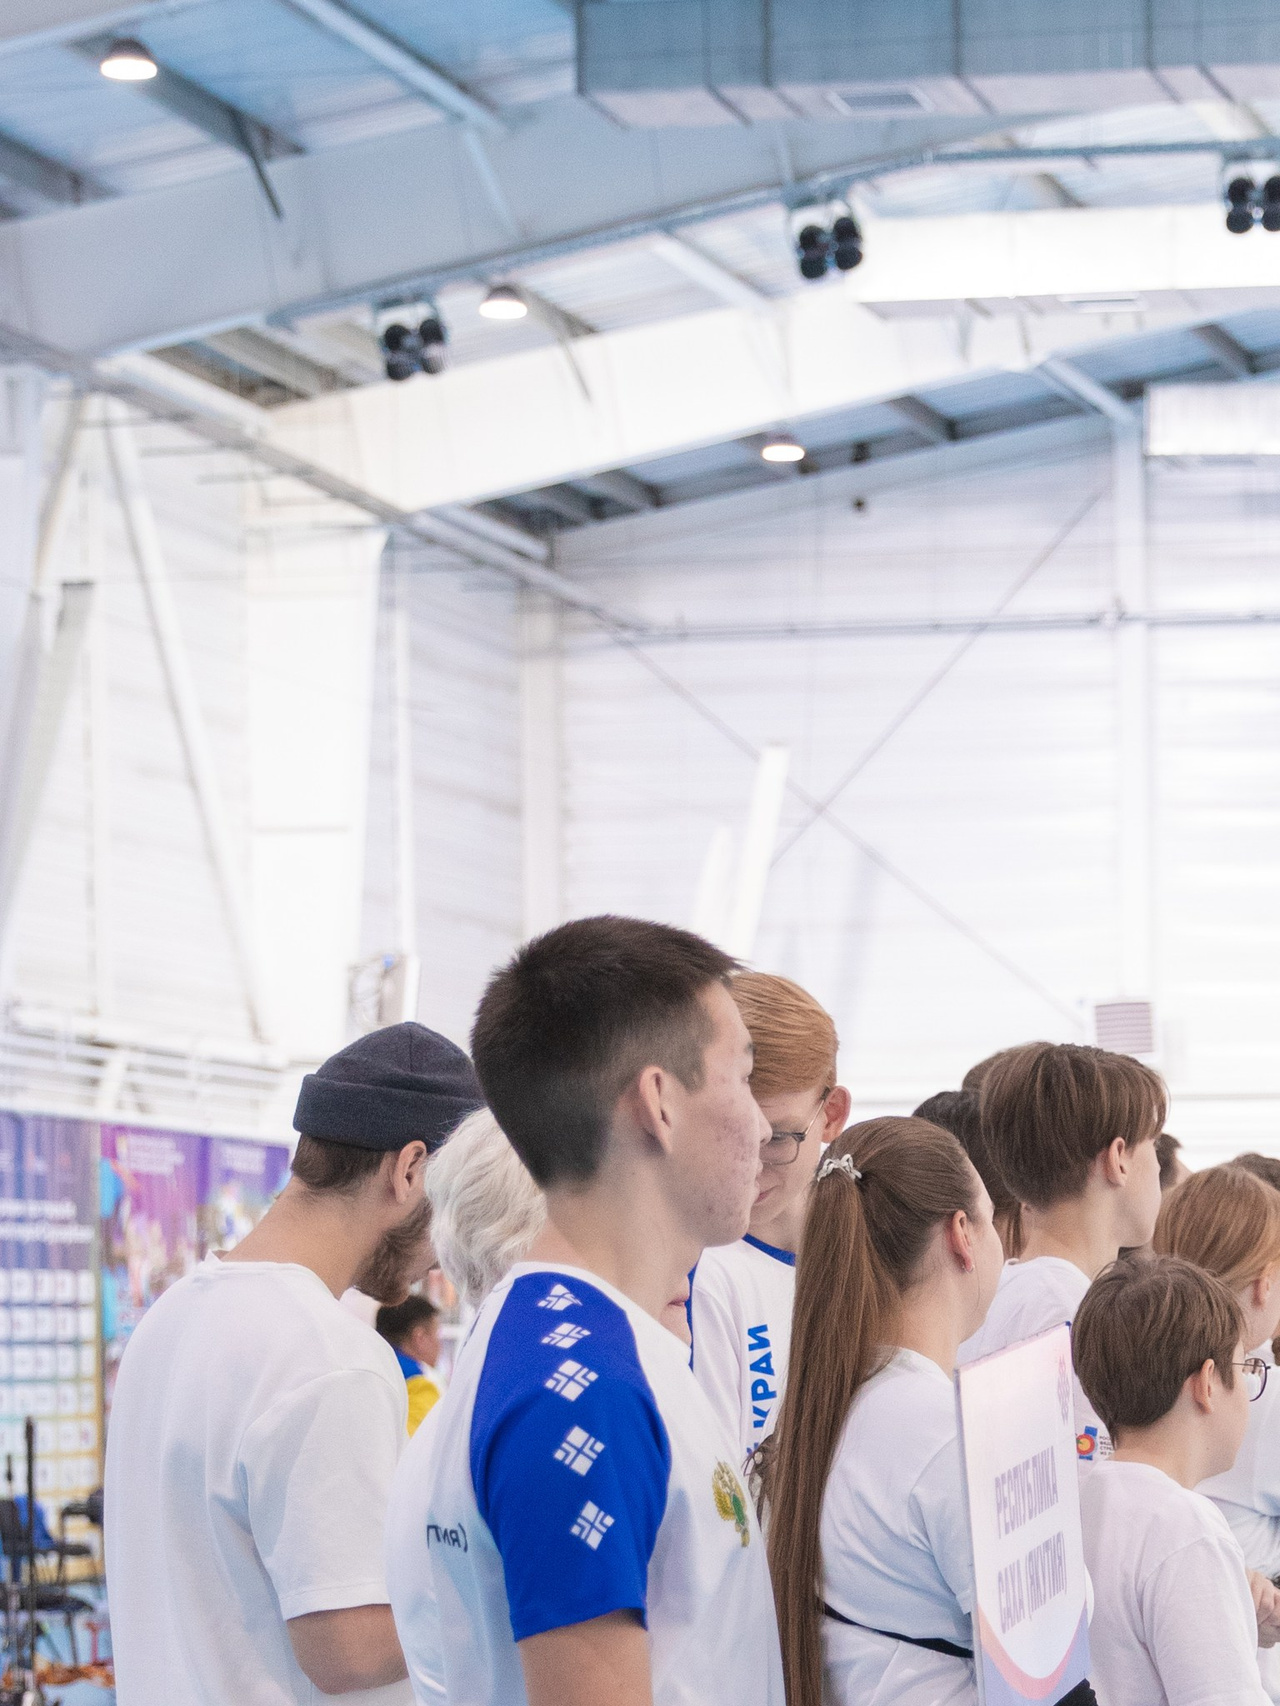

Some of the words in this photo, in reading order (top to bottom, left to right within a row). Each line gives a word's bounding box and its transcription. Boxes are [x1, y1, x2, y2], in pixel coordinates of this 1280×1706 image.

[994, 1445, 1059, 1540] РЕСПУБЛИКА
[998, 1558, 1025, 1635] САХА
[1025, 1530, 1067, 1622] (ЯКУТИЯ)
